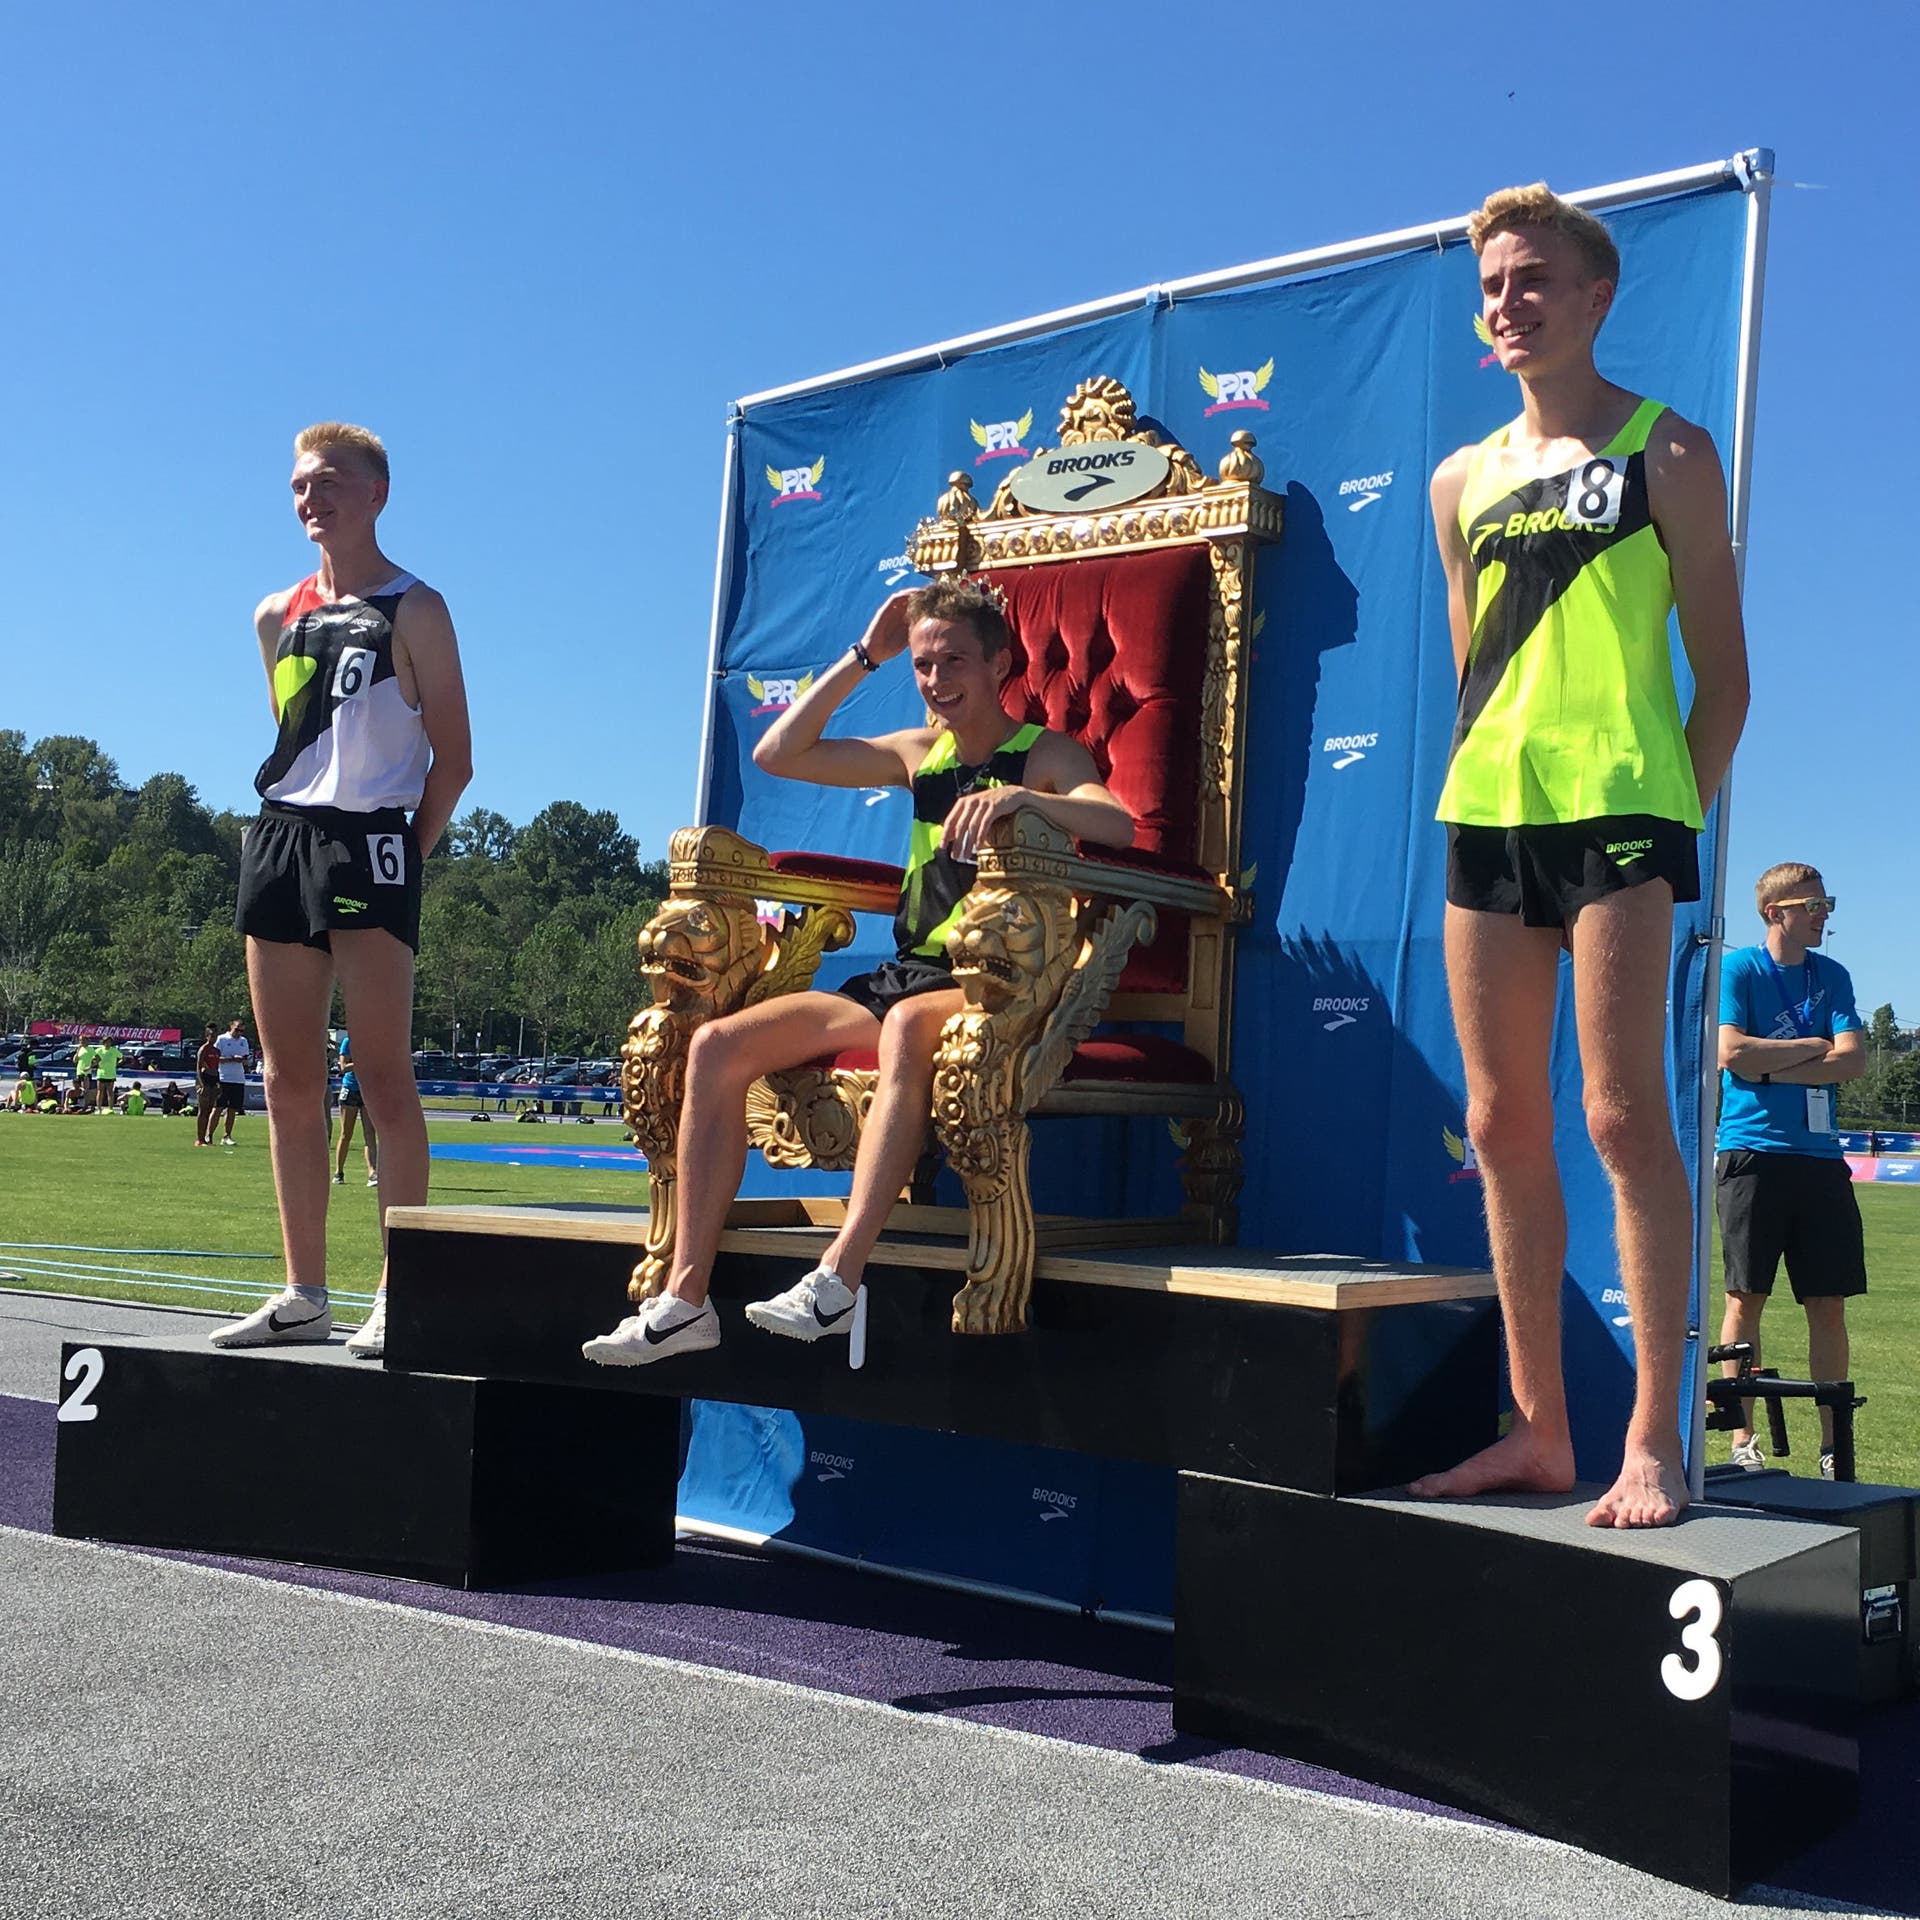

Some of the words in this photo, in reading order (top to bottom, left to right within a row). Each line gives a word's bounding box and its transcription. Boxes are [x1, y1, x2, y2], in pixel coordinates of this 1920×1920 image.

[1216, 370, 1257, 404] PR
[985, 421, 1019, 452] PR
[1047, 450, 1136, 475] BROOKS
[780, 466, 814, 497] PR
[1338, 471, 1394, 495] BROOKS
[1577, 458, 1615, 519] 8
[340, 651, 367, 696] 6
[762, 679, 798, 706] PR
[1323, 732, 1379, 752] BROOKS
[377, 836, 399, 881] 6
[1605, 839, 1653, 854] BROOKS
[333, 896, 369, 910] BROOKS
[1312, 997, 1370, 1011] BROOKS
[61, 1024, 86, 1036] SLAY
[95, 1025, 163, 1040] BACKSTRETCH
[57, 1347, 105, 1422] 2
[810, 1450, 855, 1470] BROOKS
[1032, 1487, 1078, 1509] BROOKS
[1661, 1579, 1722, 1701] 3
